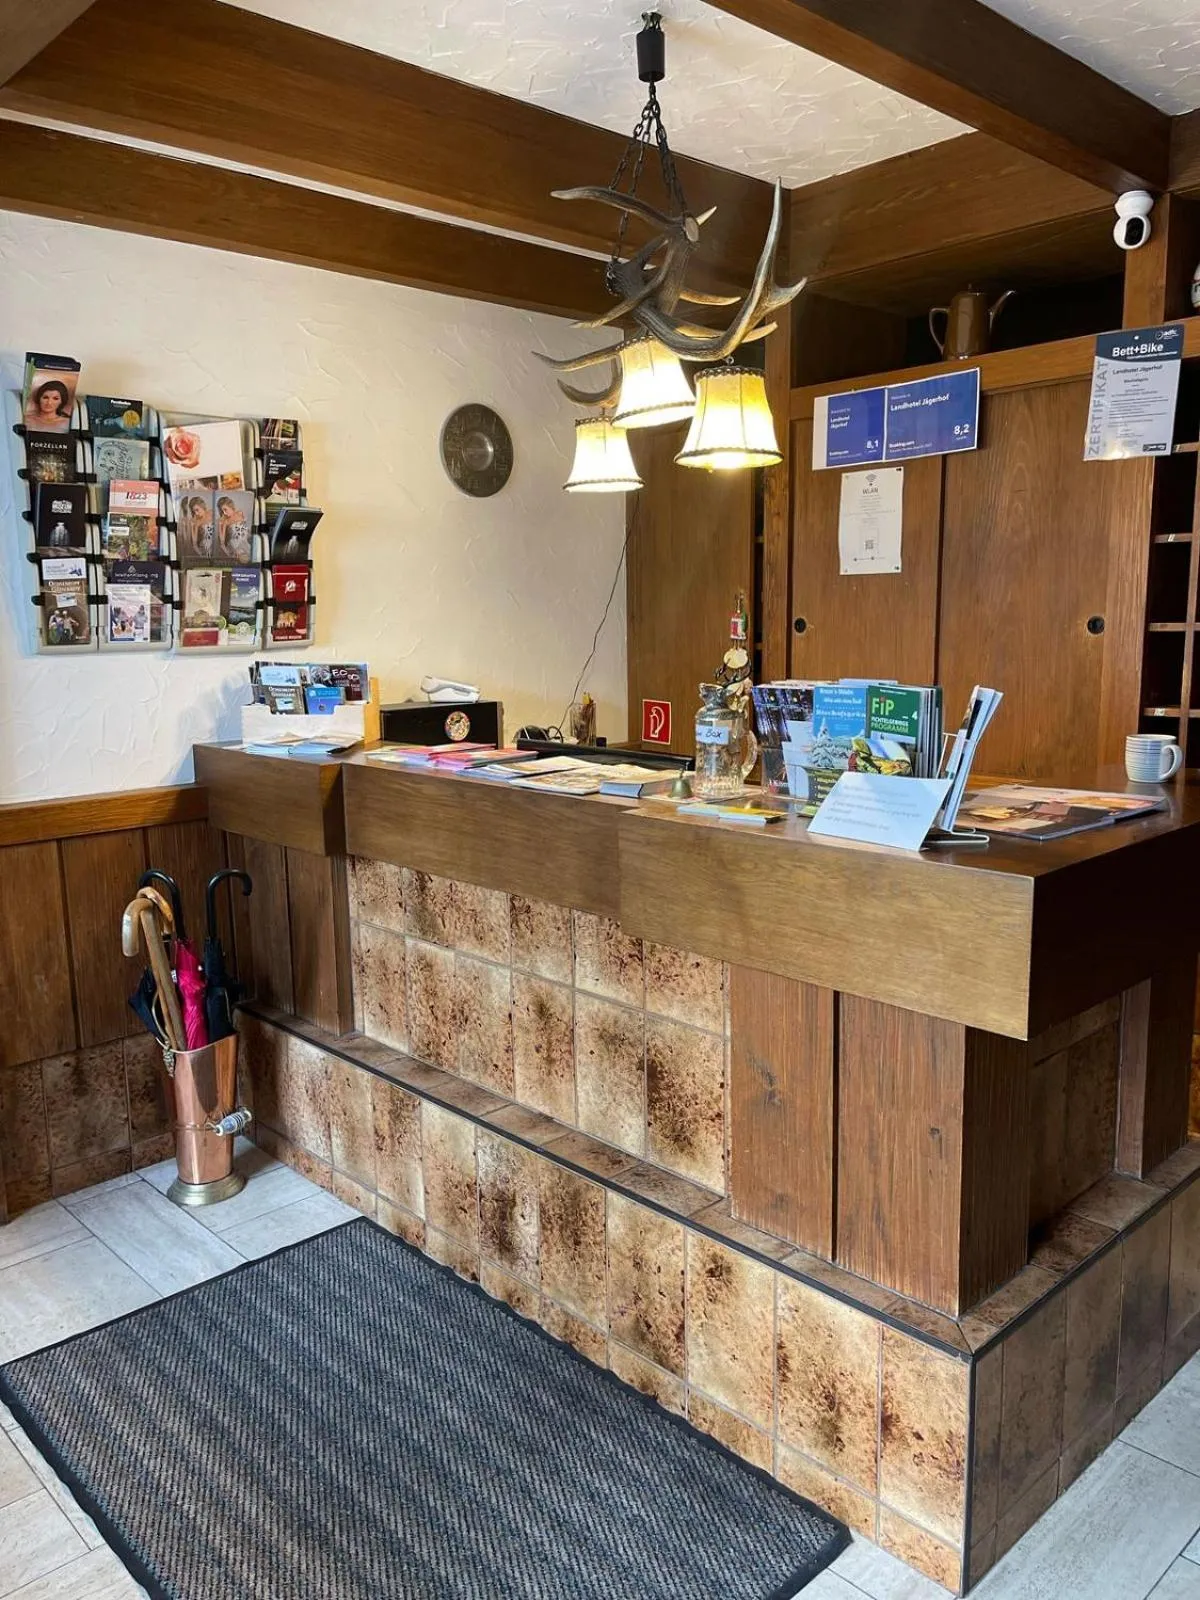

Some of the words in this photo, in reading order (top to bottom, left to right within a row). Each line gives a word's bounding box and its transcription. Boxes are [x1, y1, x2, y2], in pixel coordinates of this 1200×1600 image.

[1112, 343, 1164, 357] Bett+Bike
[890, 399, 921, 411] Landhotel
[922, 393, 950, 406] Jägerhof
[1088, 363, 1108, 455] ZERTIFIKAT
[954, 424, 970, 435] 8,2
[30, 441, 67, 449] PORZELLAN
[866, 439, 879, 449] 8,1
